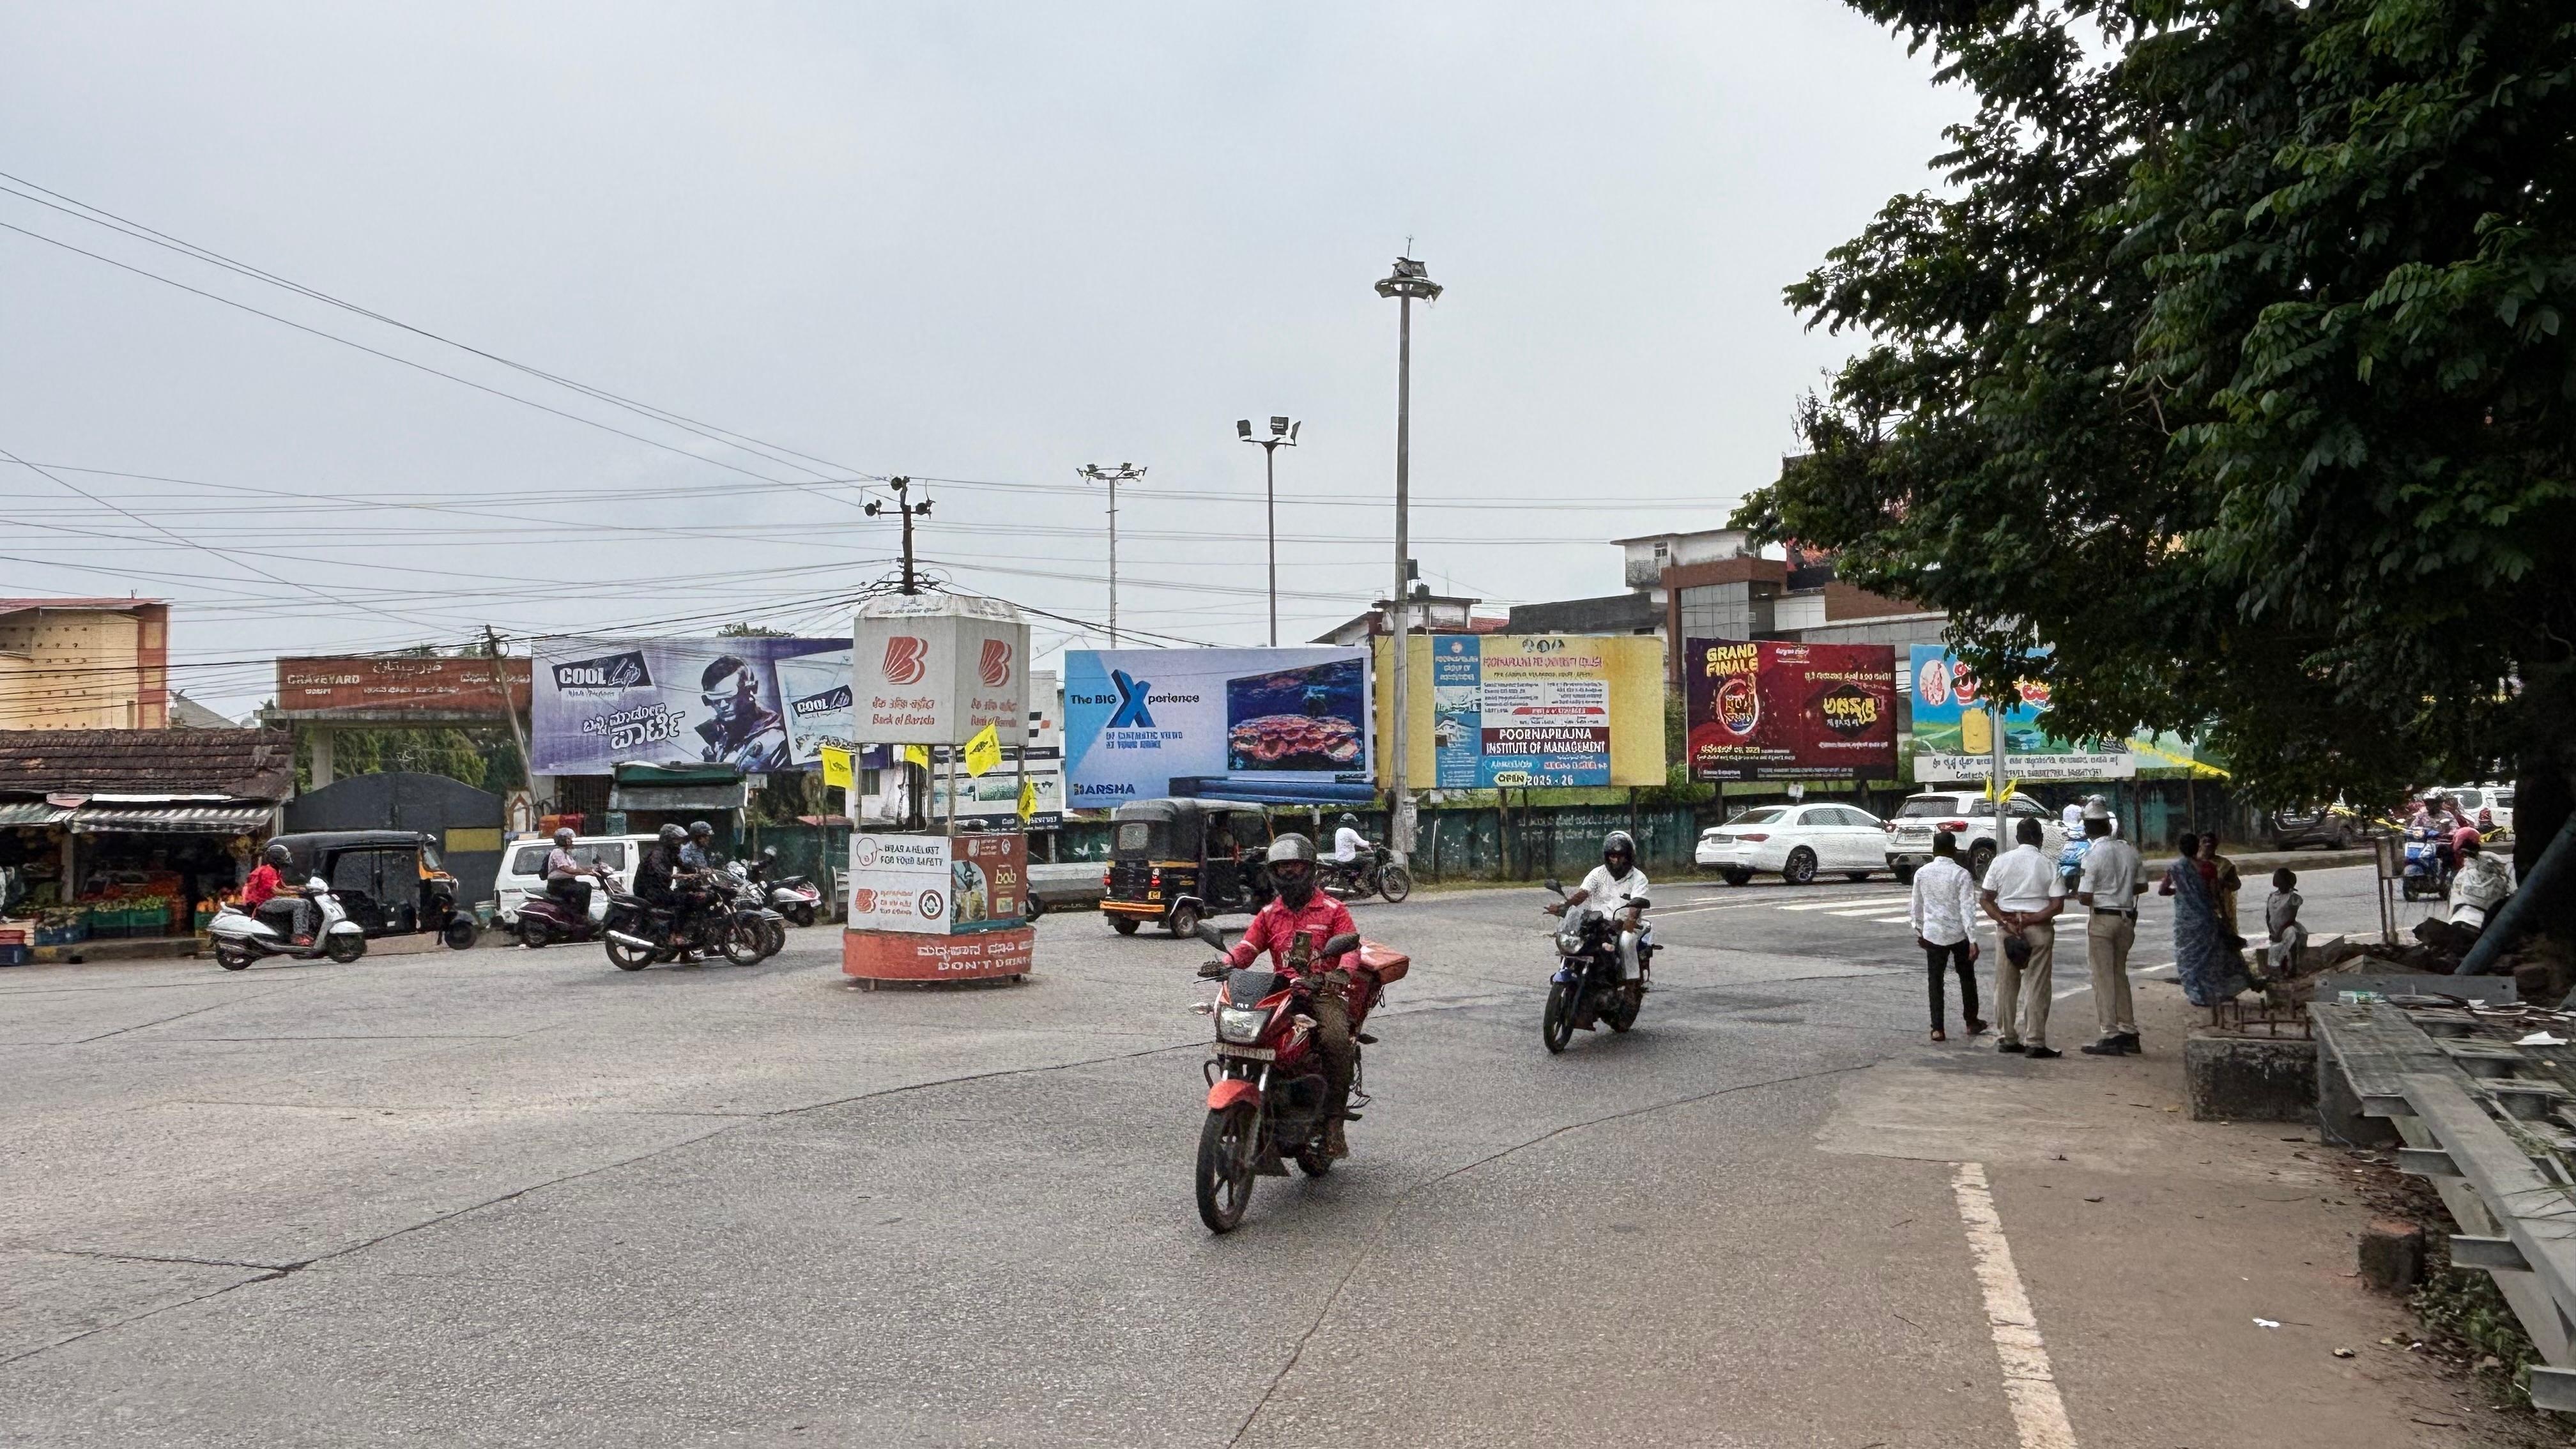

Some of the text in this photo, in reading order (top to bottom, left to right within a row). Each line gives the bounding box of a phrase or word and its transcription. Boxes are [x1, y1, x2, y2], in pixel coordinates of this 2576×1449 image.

[1706, 643, 1757, 662] GRAND
[1706, 657, 1759, 677] FINALE
[288, 675, 360, 685] GRAVEYARD
[560, 668, 606, 684] COOL
[1071, 694, 1092, 704] The
[1095, 694, 1117, 704] BIG
[797, 698, 829, 714] COOL
[873, 714, 893, 724] Bank
[1499, 728, 1591, 740] POORNAPRAJNA
[1486, 741, 1605, 755] INSTITUTE OF MANAGEMENT
[1498, 774, 1524, 783] OPEN
[1073, 783, 1135, 795] HARSHA
[938, 960, 992, 970] DON'T
